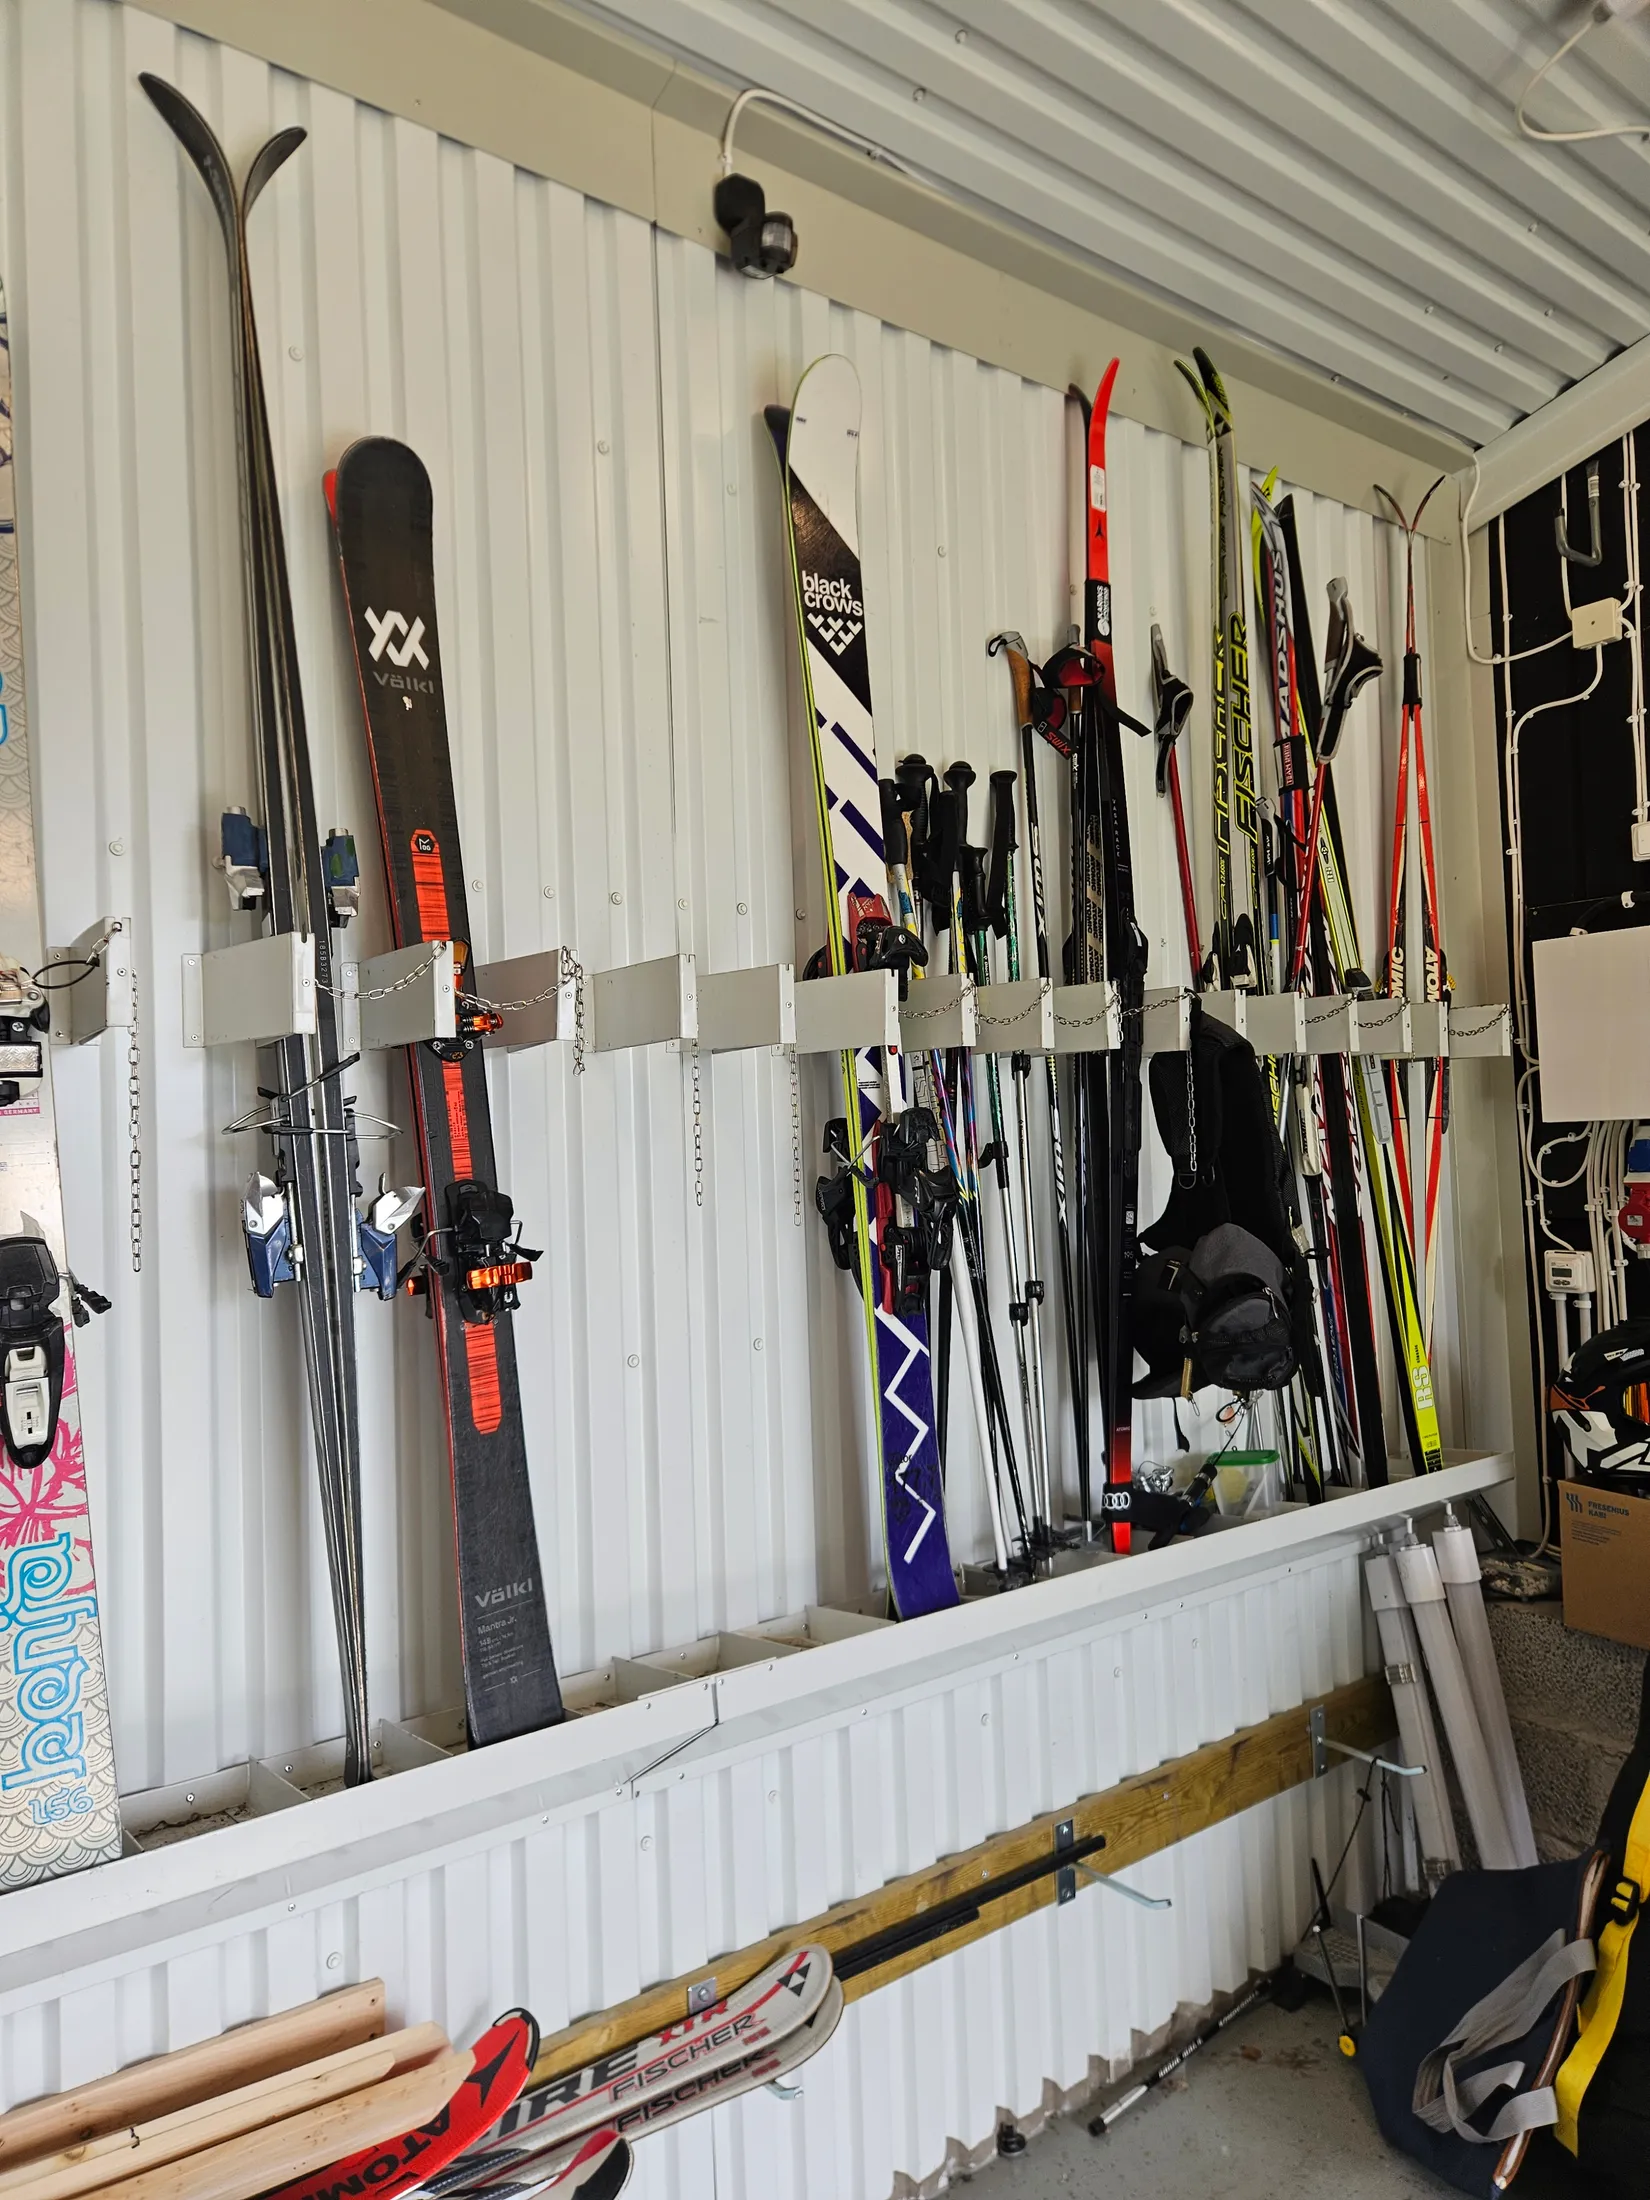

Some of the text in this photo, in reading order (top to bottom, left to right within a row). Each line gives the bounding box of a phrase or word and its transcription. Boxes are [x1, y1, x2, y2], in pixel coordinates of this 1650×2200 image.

[802, 570, 852, 599] black
[804, 591, 863, 616] crows
[373, 671, 434, 694] Völkl
[1229, 611, 1258, 844] FISCHER
[4, 1108, 38, 1116] GERMANY
[1412, 1366, 1434, 1410] RS
[1588, 1501, 1630, 1517] FRESENIUS
[1588, 1509, 1607, 1519] KABI
[475, 1578, 533, 1607] Völkl
[653, 1999, 729, 2046] XTR
[612, 2012, 758, 2099] FISCHER
